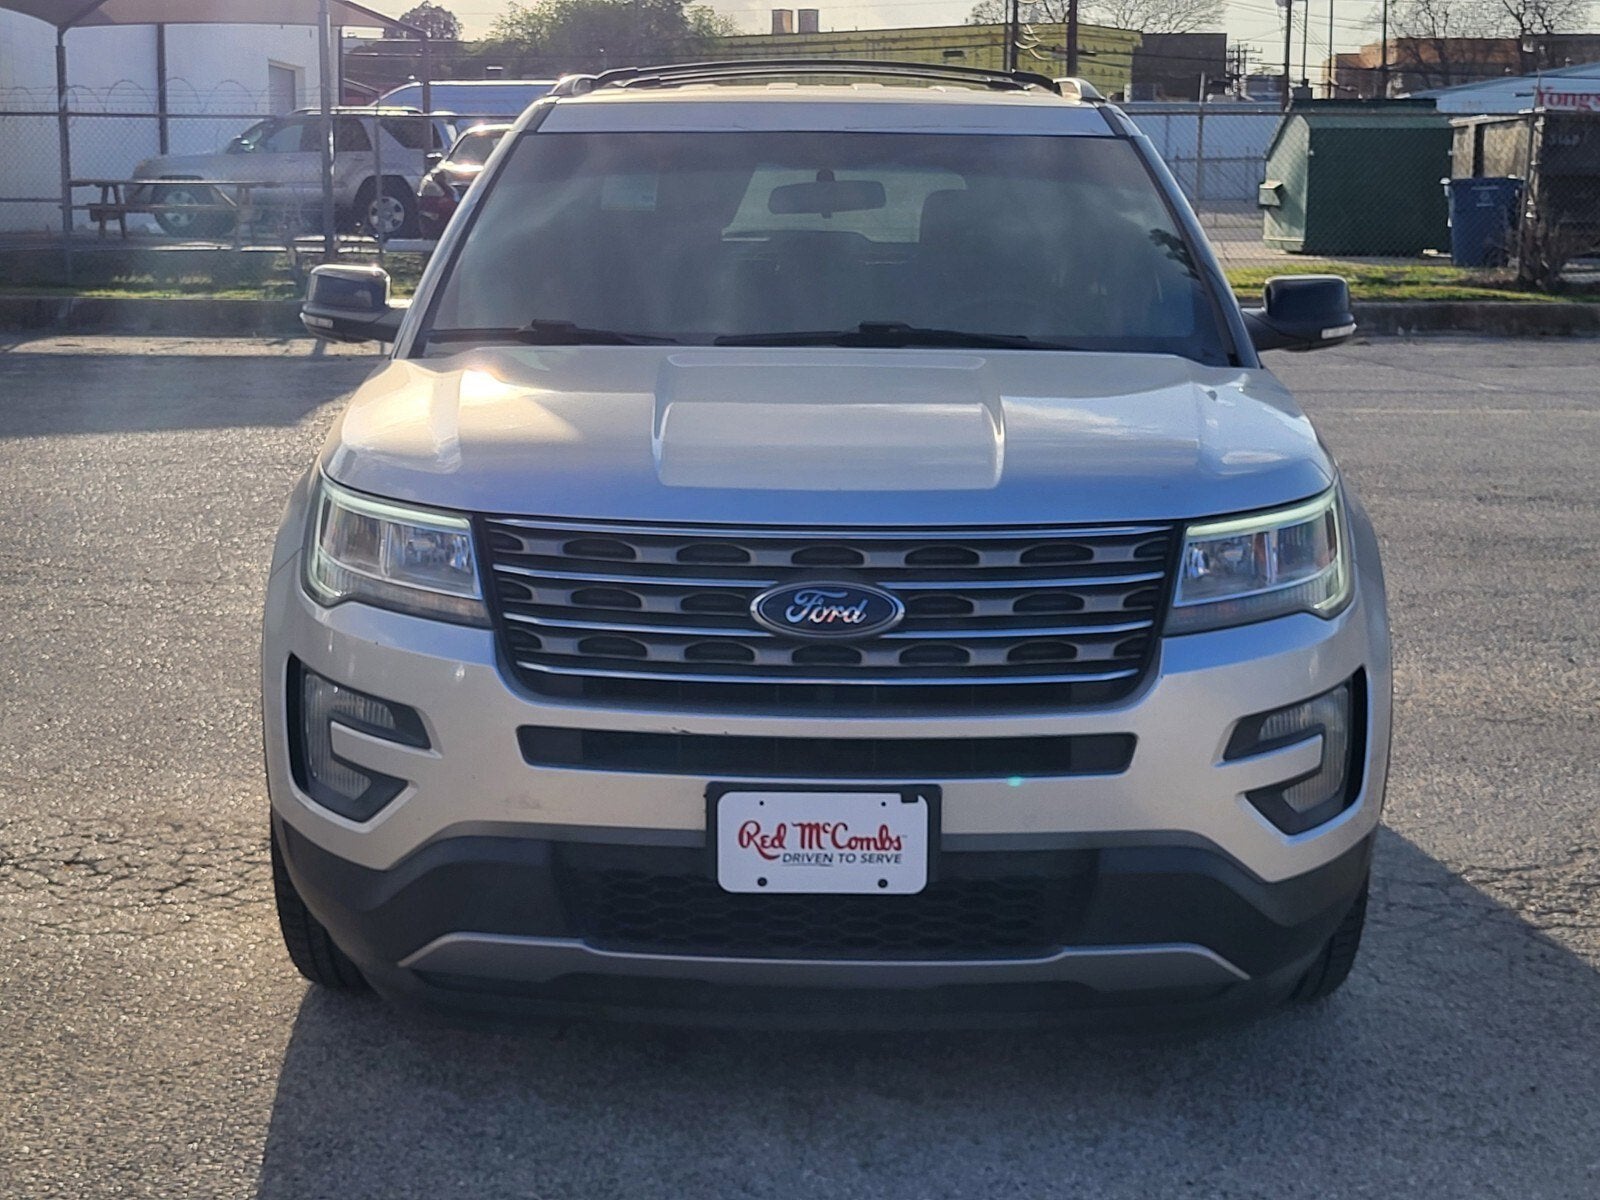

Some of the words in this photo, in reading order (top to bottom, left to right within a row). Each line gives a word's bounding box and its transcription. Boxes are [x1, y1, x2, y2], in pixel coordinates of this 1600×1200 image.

[785, 589, 868, 623] Ford
[738, 820, 787, 860] Red
[791, 822, 902, 850] McCombs
[782, 853, 834, 864] DRIVEN
[839, 853, 857, 864] TO
[860, 853, 902, 864] SERVE
